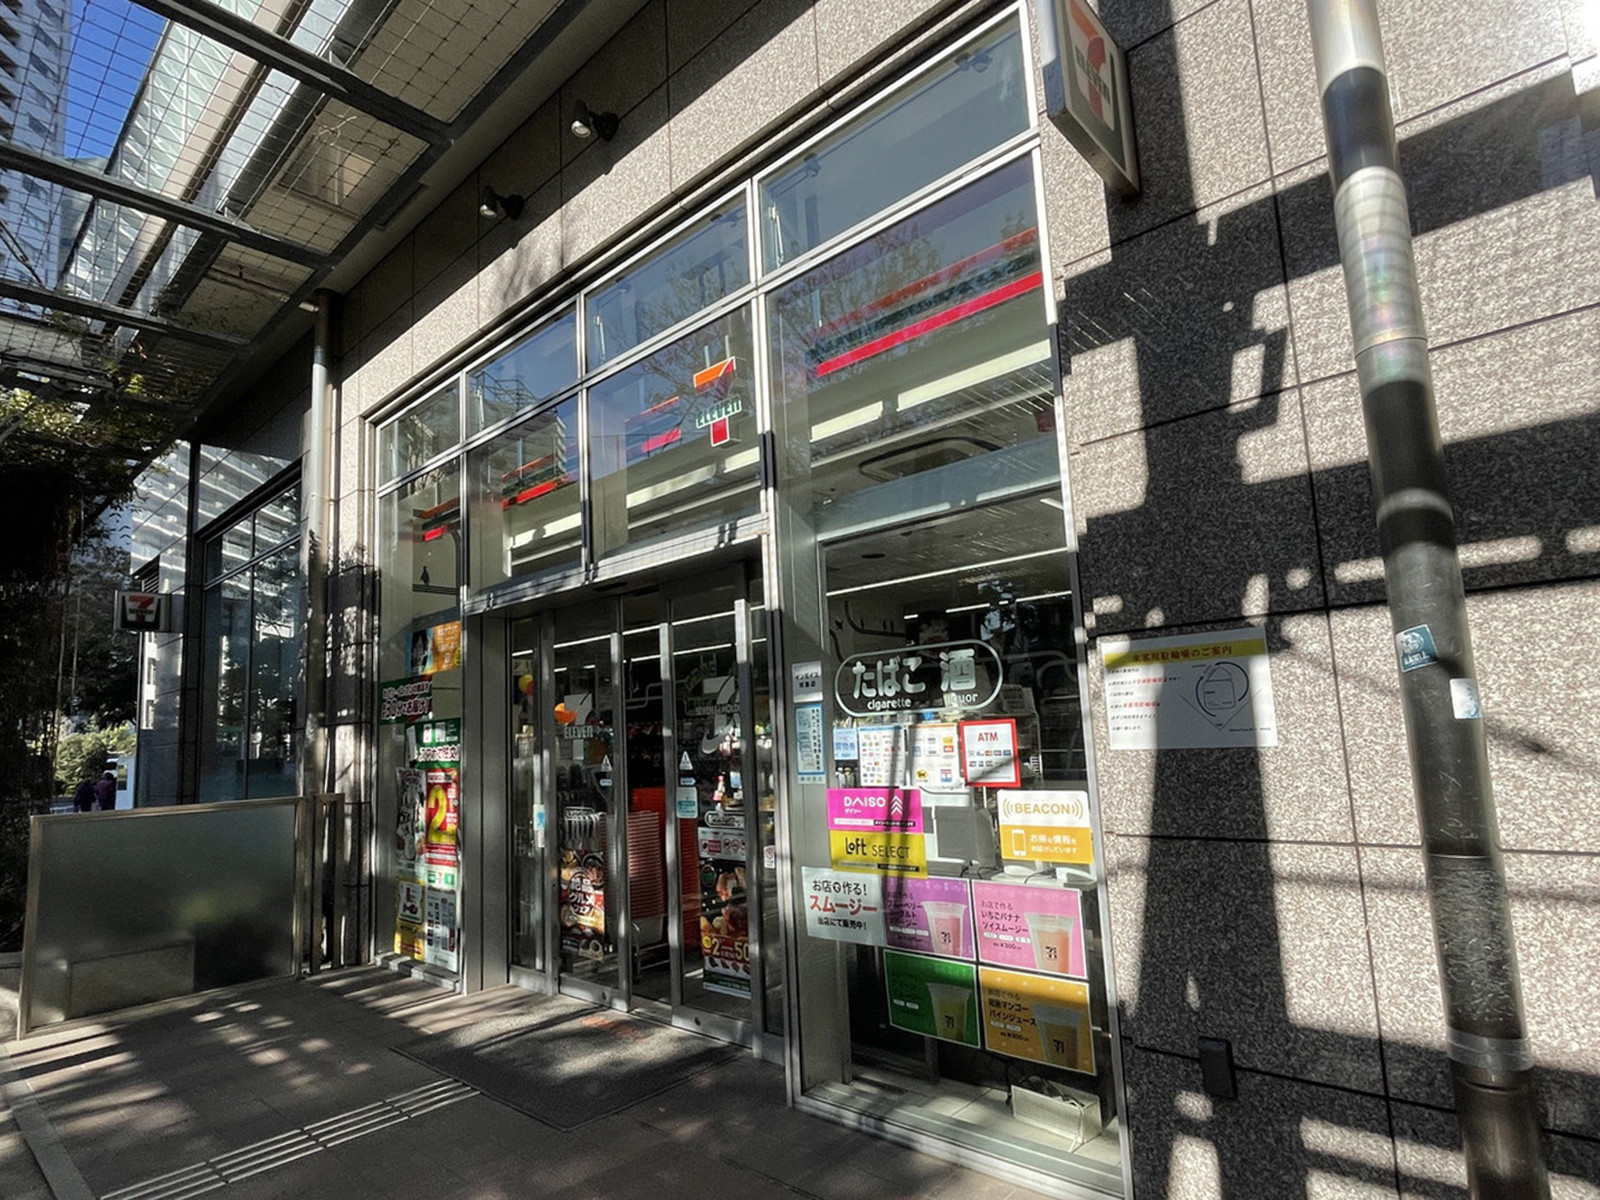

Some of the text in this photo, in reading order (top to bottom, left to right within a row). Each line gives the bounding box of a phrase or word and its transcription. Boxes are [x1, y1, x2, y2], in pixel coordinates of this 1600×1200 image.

[852, 648, 976, 699] たばこ 酒
[866, 697, 912, 711] cigarette
[977, 732, 999, 742] ATM
[843, 796, 886, 808] DAISO
[1014, 803, 1071, 815] BEACON
[871, 844, 911, 859] SELECT
[809, 894, 878, 916] スムージー
[981, 909, 1021, 922] いちごバナナ
[982, 921, 1029, 934] ソイスムージー
[988, 1011, 1038, 1027] パインジュース
